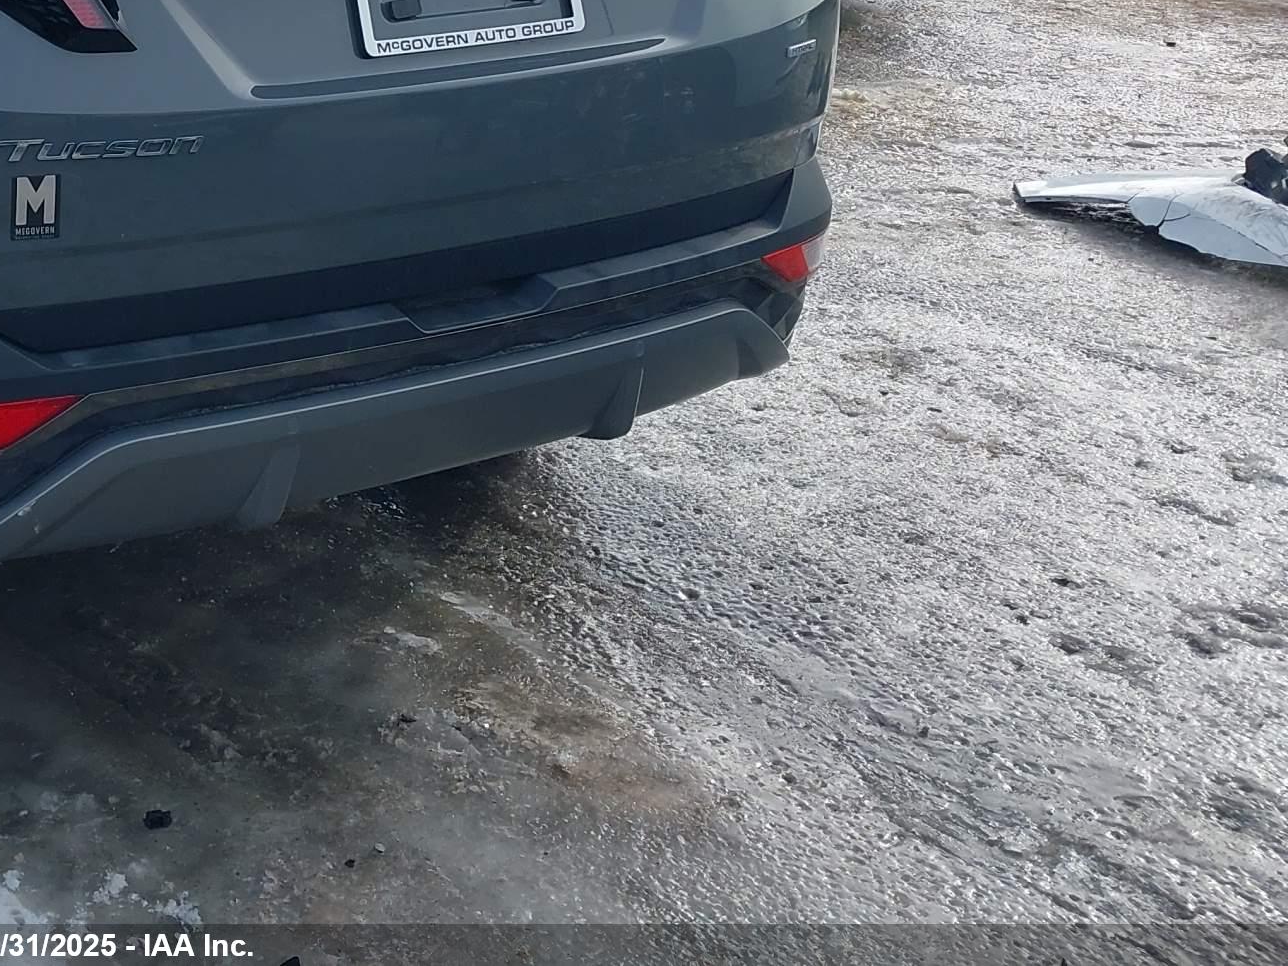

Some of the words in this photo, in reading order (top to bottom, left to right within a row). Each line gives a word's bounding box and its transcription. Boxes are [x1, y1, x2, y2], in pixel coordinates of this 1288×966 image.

[475, 27, 517, 44] AUTO
[521, 19, 575, 37] GROUP
[15, 175, 56, 226] M
